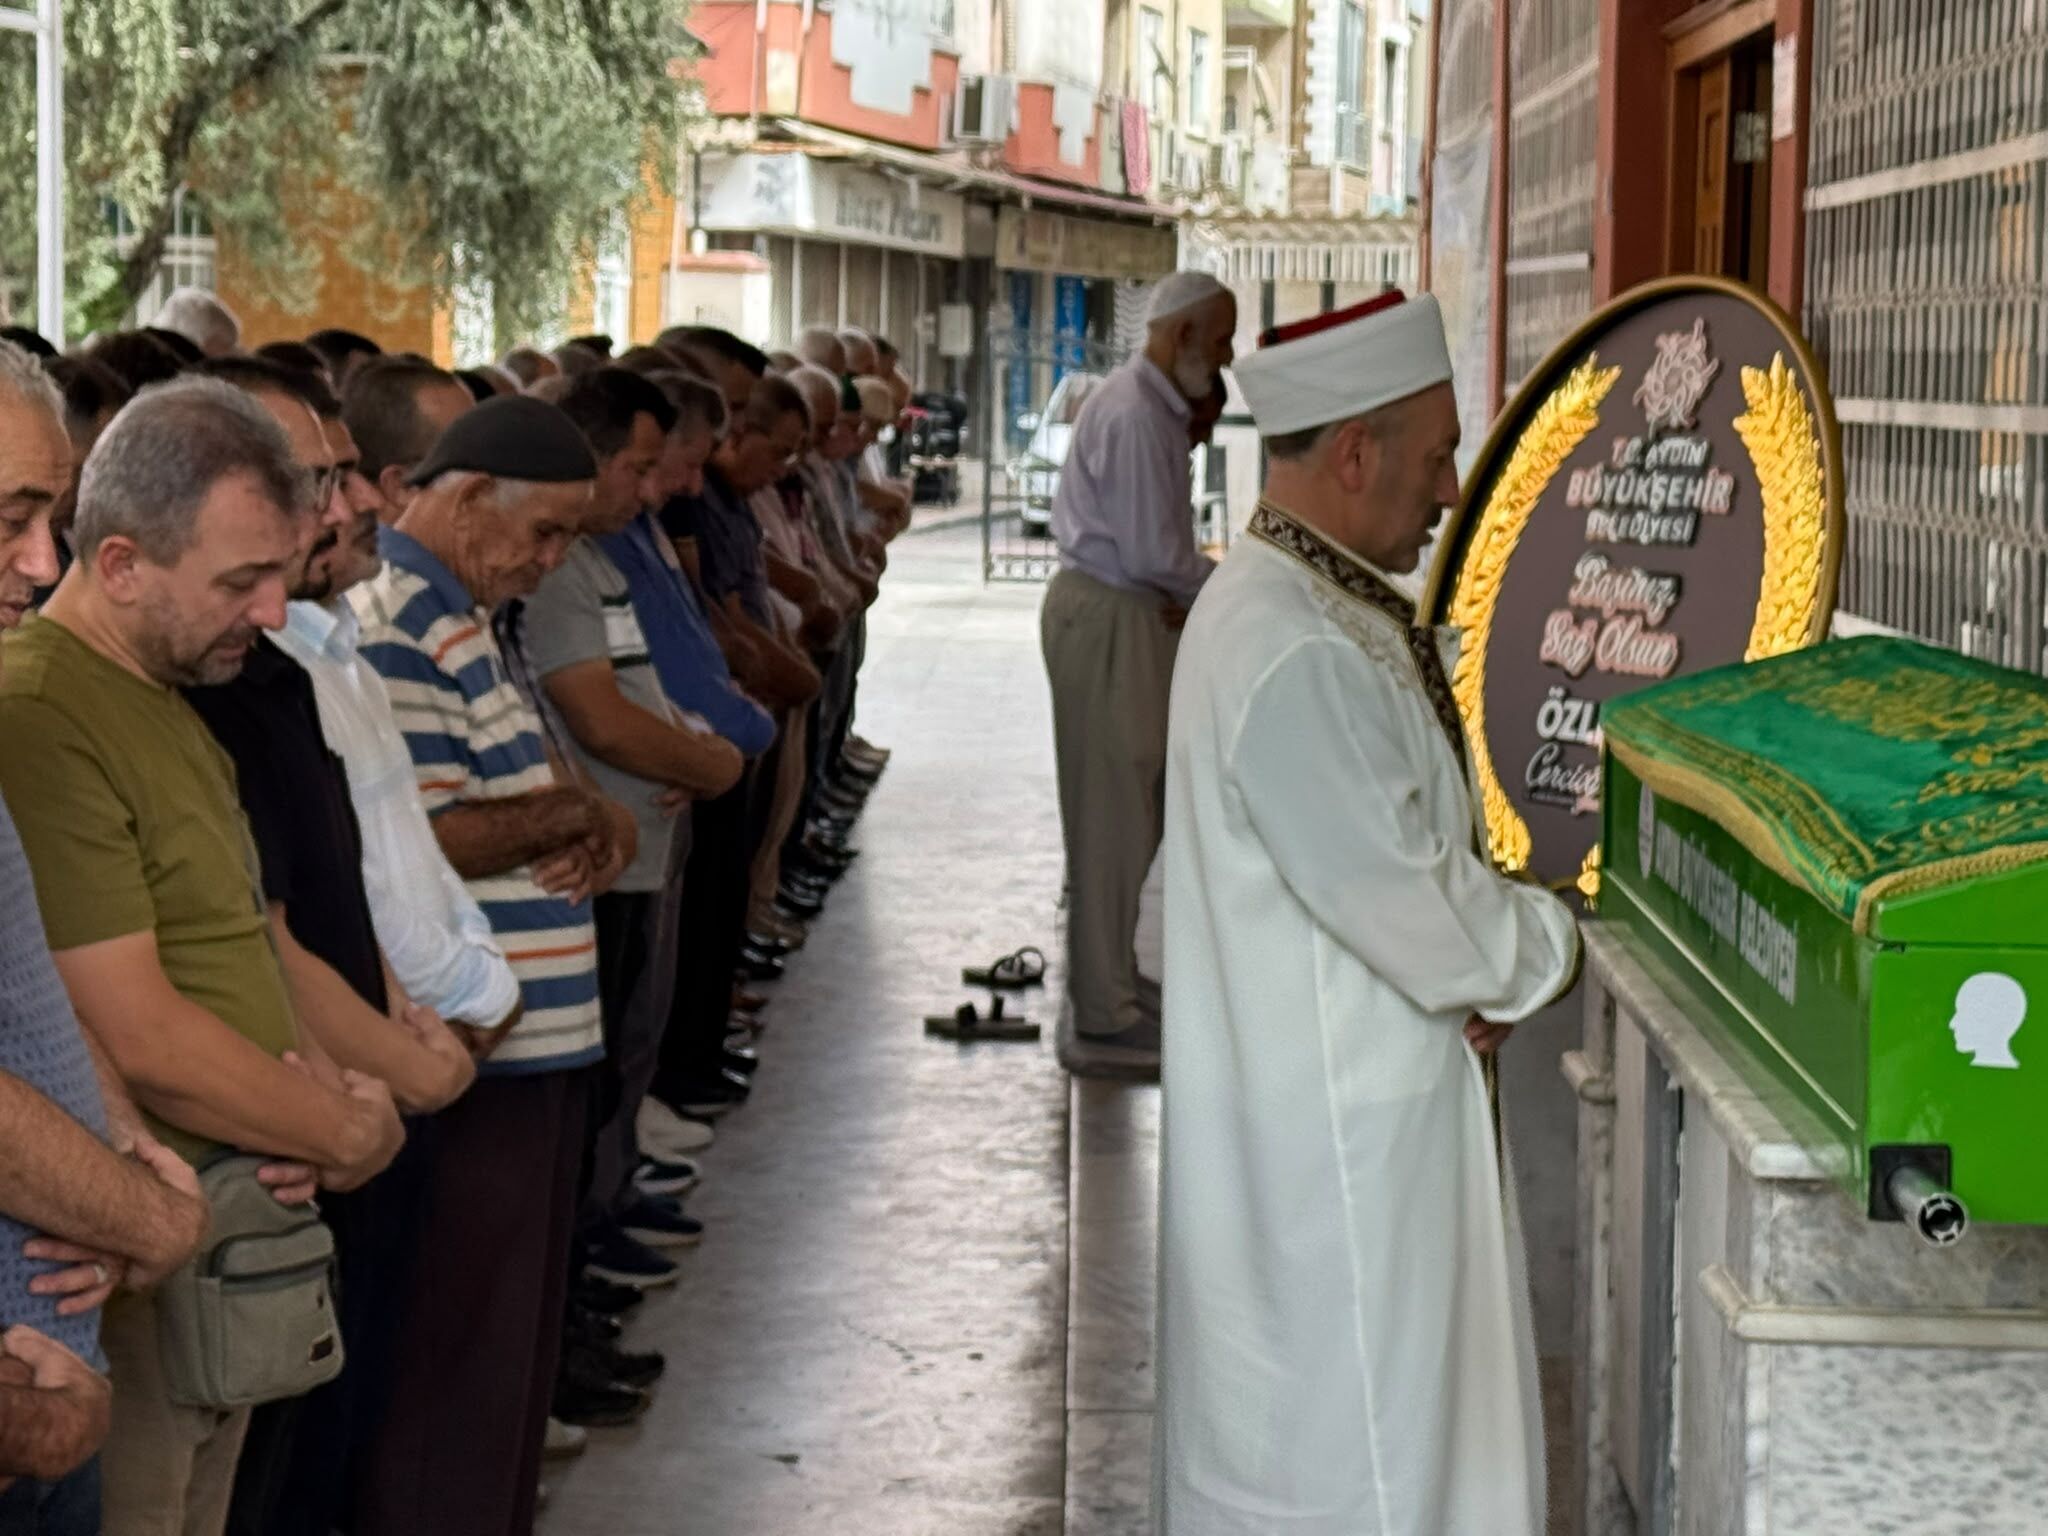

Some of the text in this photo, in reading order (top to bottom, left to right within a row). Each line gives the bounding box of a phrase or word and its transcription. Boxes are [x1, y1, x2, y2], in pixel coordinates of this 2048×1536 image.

[1645, 437, 1708, 470] AYDIN
[1566, 464, 1735, 514] BÜYÜKŞEHİR
[1596, 616, 1677, 676] Olsun
[1536, 685, 1604, 746] ÖZL
